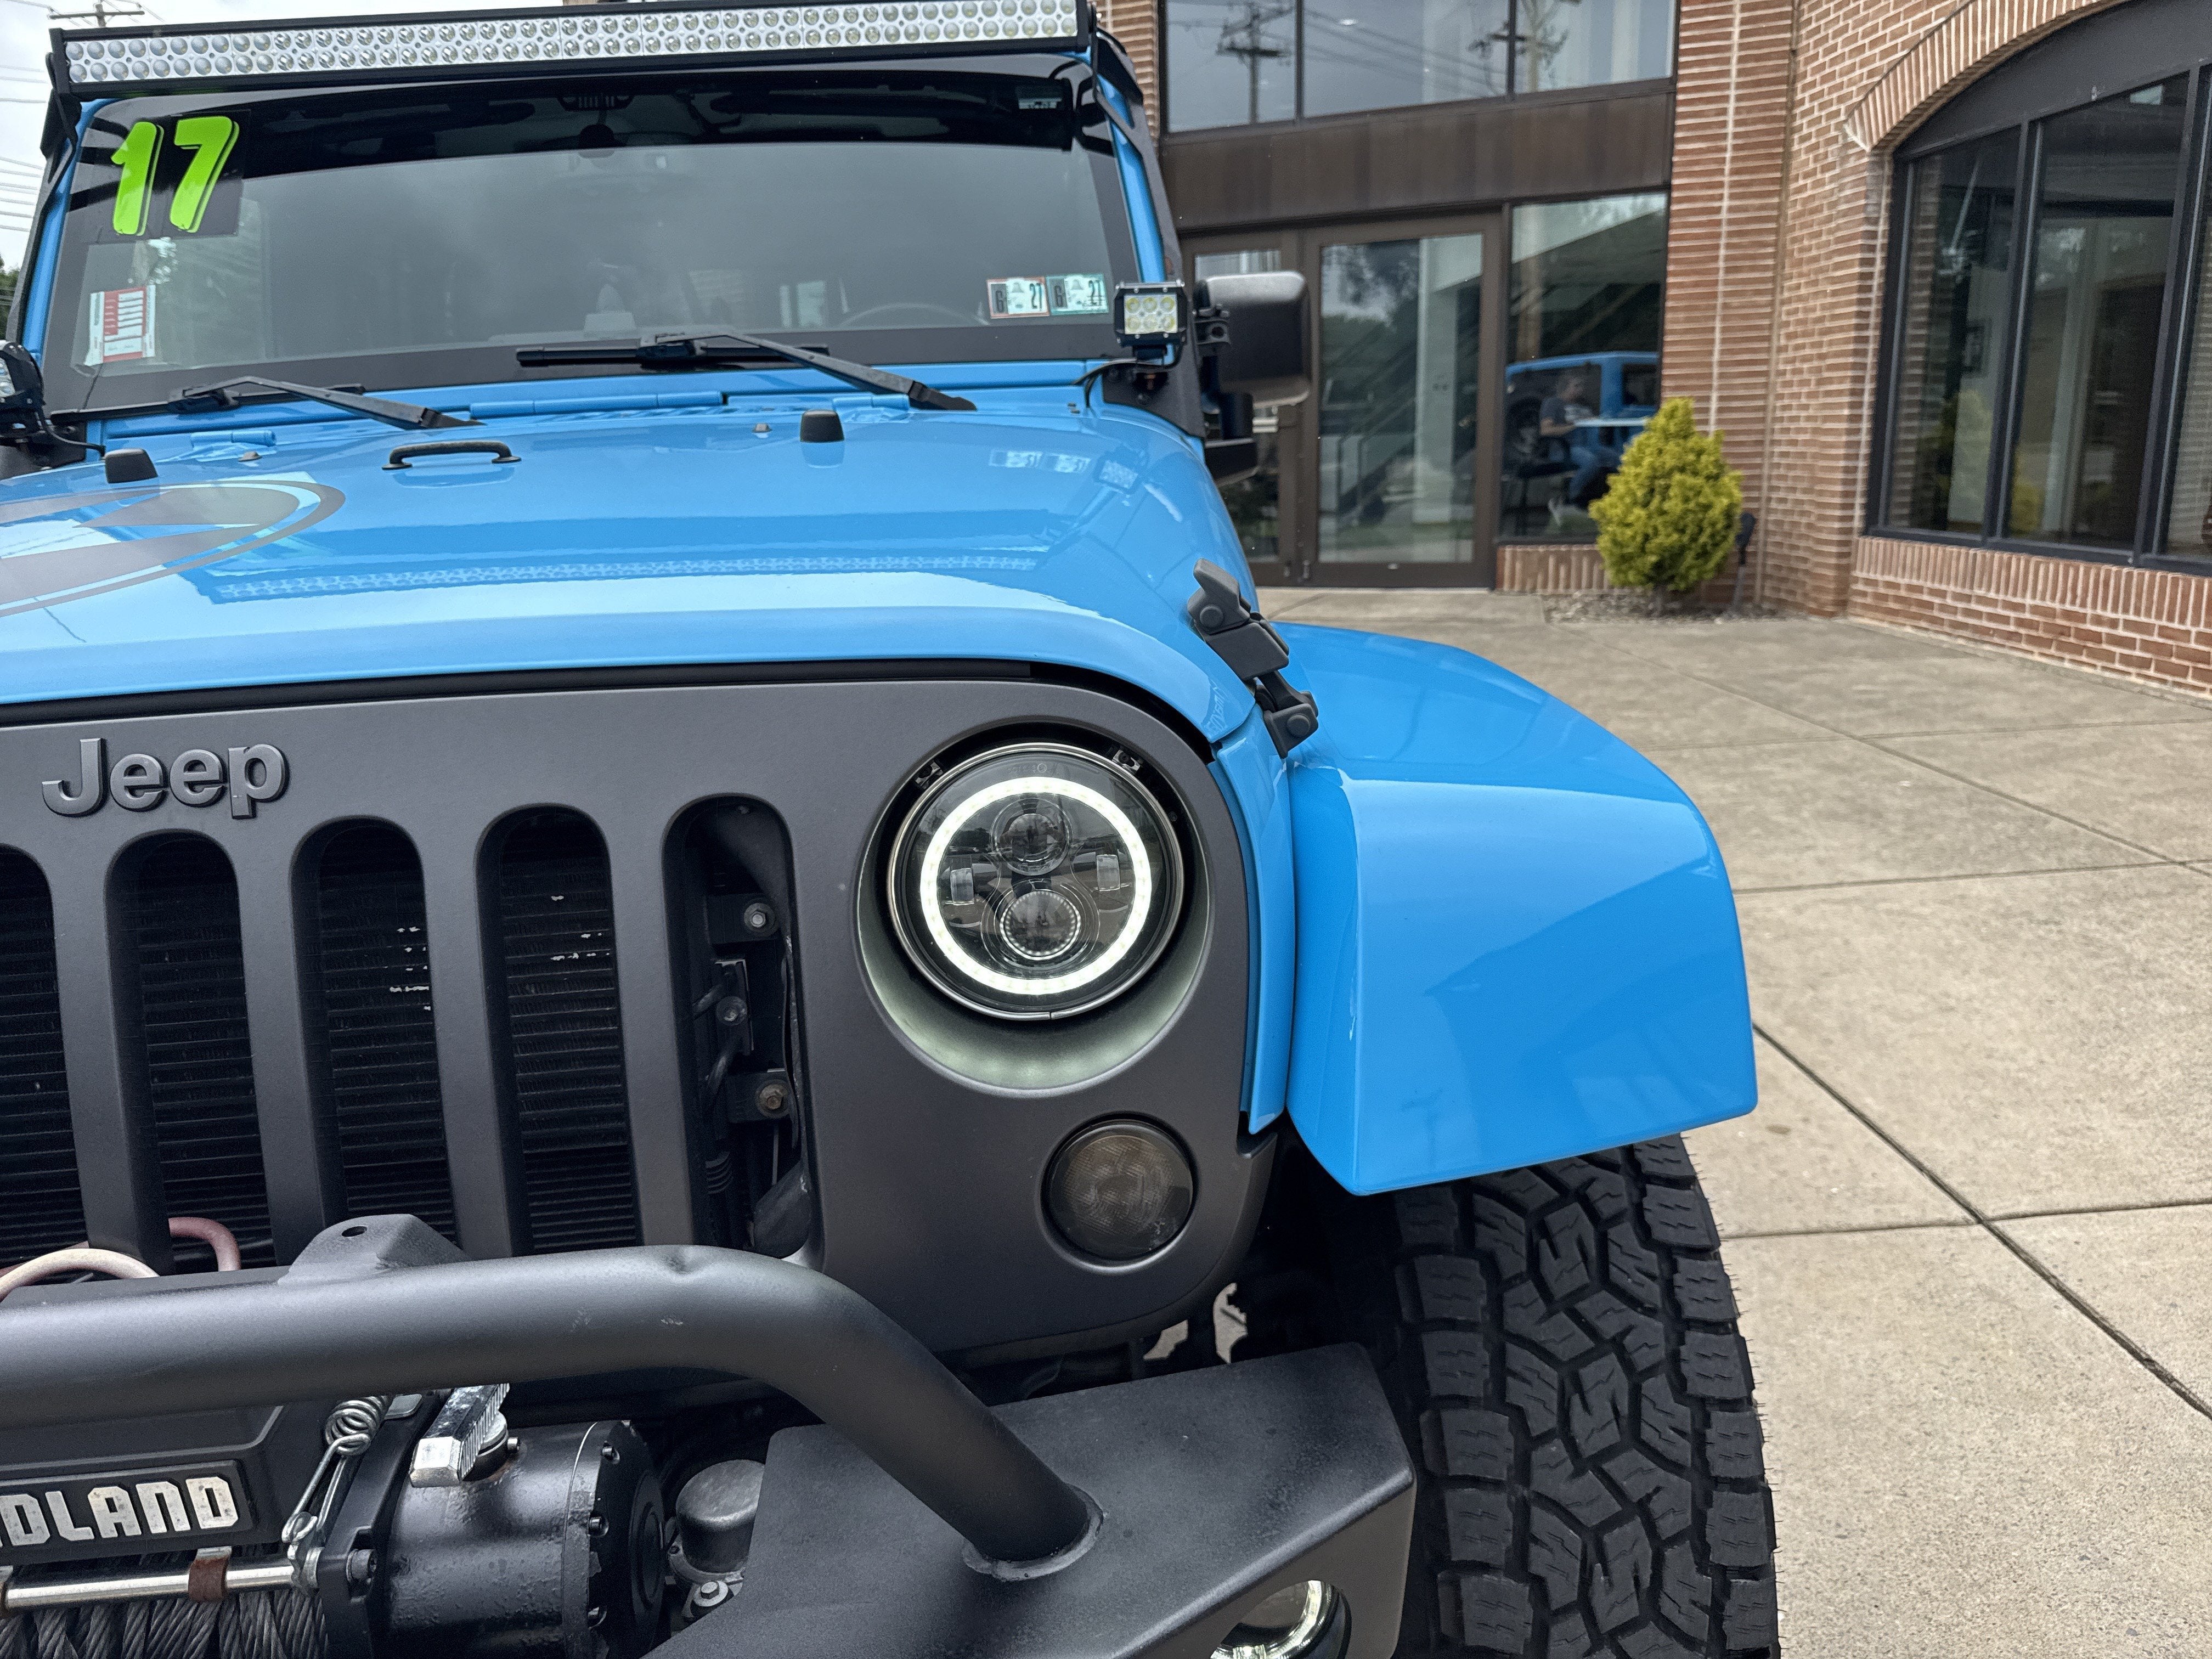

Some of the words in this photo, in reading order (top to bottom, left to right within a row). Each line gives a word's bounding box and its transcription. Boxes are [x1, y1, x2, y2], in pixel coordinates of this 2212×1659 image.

[111, 116, 239, 236] 17
[42, 738, 287, 819] Jeep
[0, 1476, 239, 1547] DLAND
